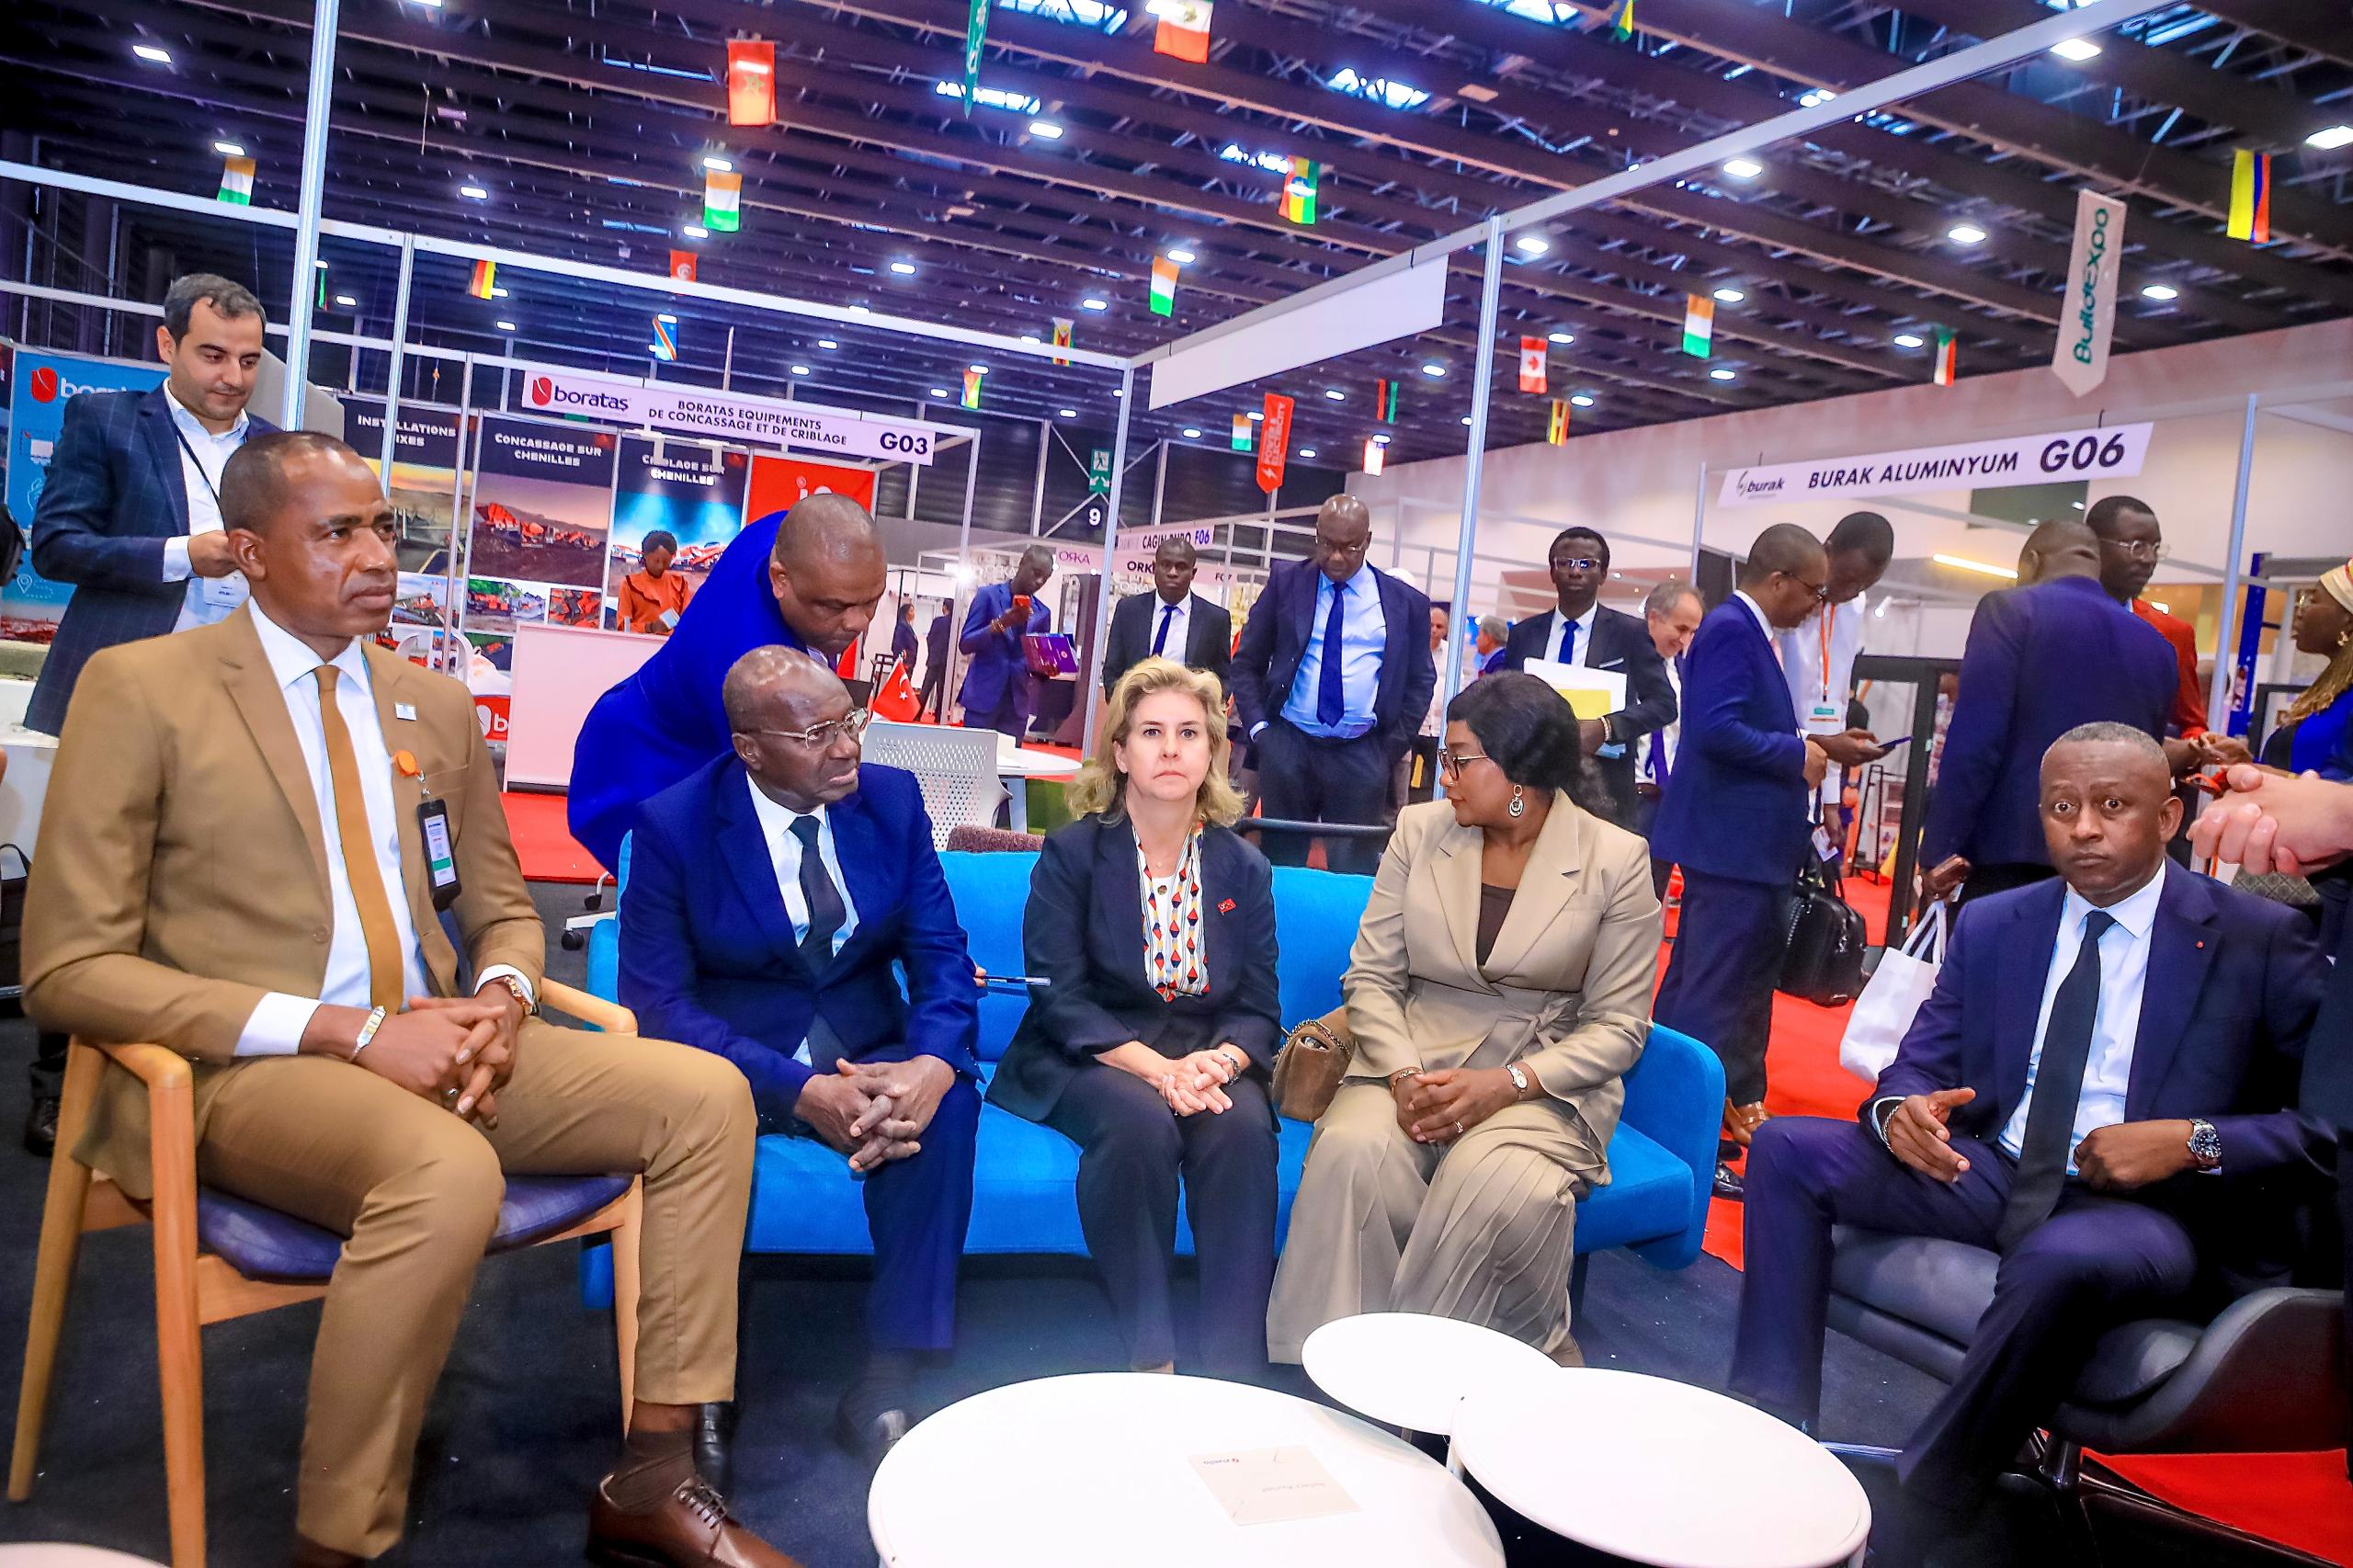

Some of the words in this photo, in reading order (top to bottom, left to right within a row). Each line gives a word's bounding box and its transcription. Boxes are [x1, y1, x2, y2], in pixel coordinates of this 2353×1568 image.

[358, 415, 457, 437] INSTLLATIONS
[677, 400, 734, 417] BORATAS
[738, 409, 822, 430] EQUIPEMENTS
[649, 408, 664, 419] DE
[668, 411, 752, 431] CONCASSAGE
[756, 423, 767, 434] ET
[772, 425, 787, 437] DE
[790, 428, 847, 446] CRIBLAGE
[396, 434, 426, 447] IXES
[494, 433, 574, 453] CONCASSAGE
[577, 445, 602, 457] SUR
[880, 432, 928, 455] G03
[515, 449, 581, 467] CHENILLES
[2040, 433, 2126, 473] G06
[650, 468, 715, 486] CHENILLES
[1808, 467, 1875, 489] BURAK
[1880, 451, 2019, 483] ALUMINYUM
[1747, 477, 1785, 493] burak
[1089, 507, 1101, 526] 9
[1195, 529, 1211, 545] F06
